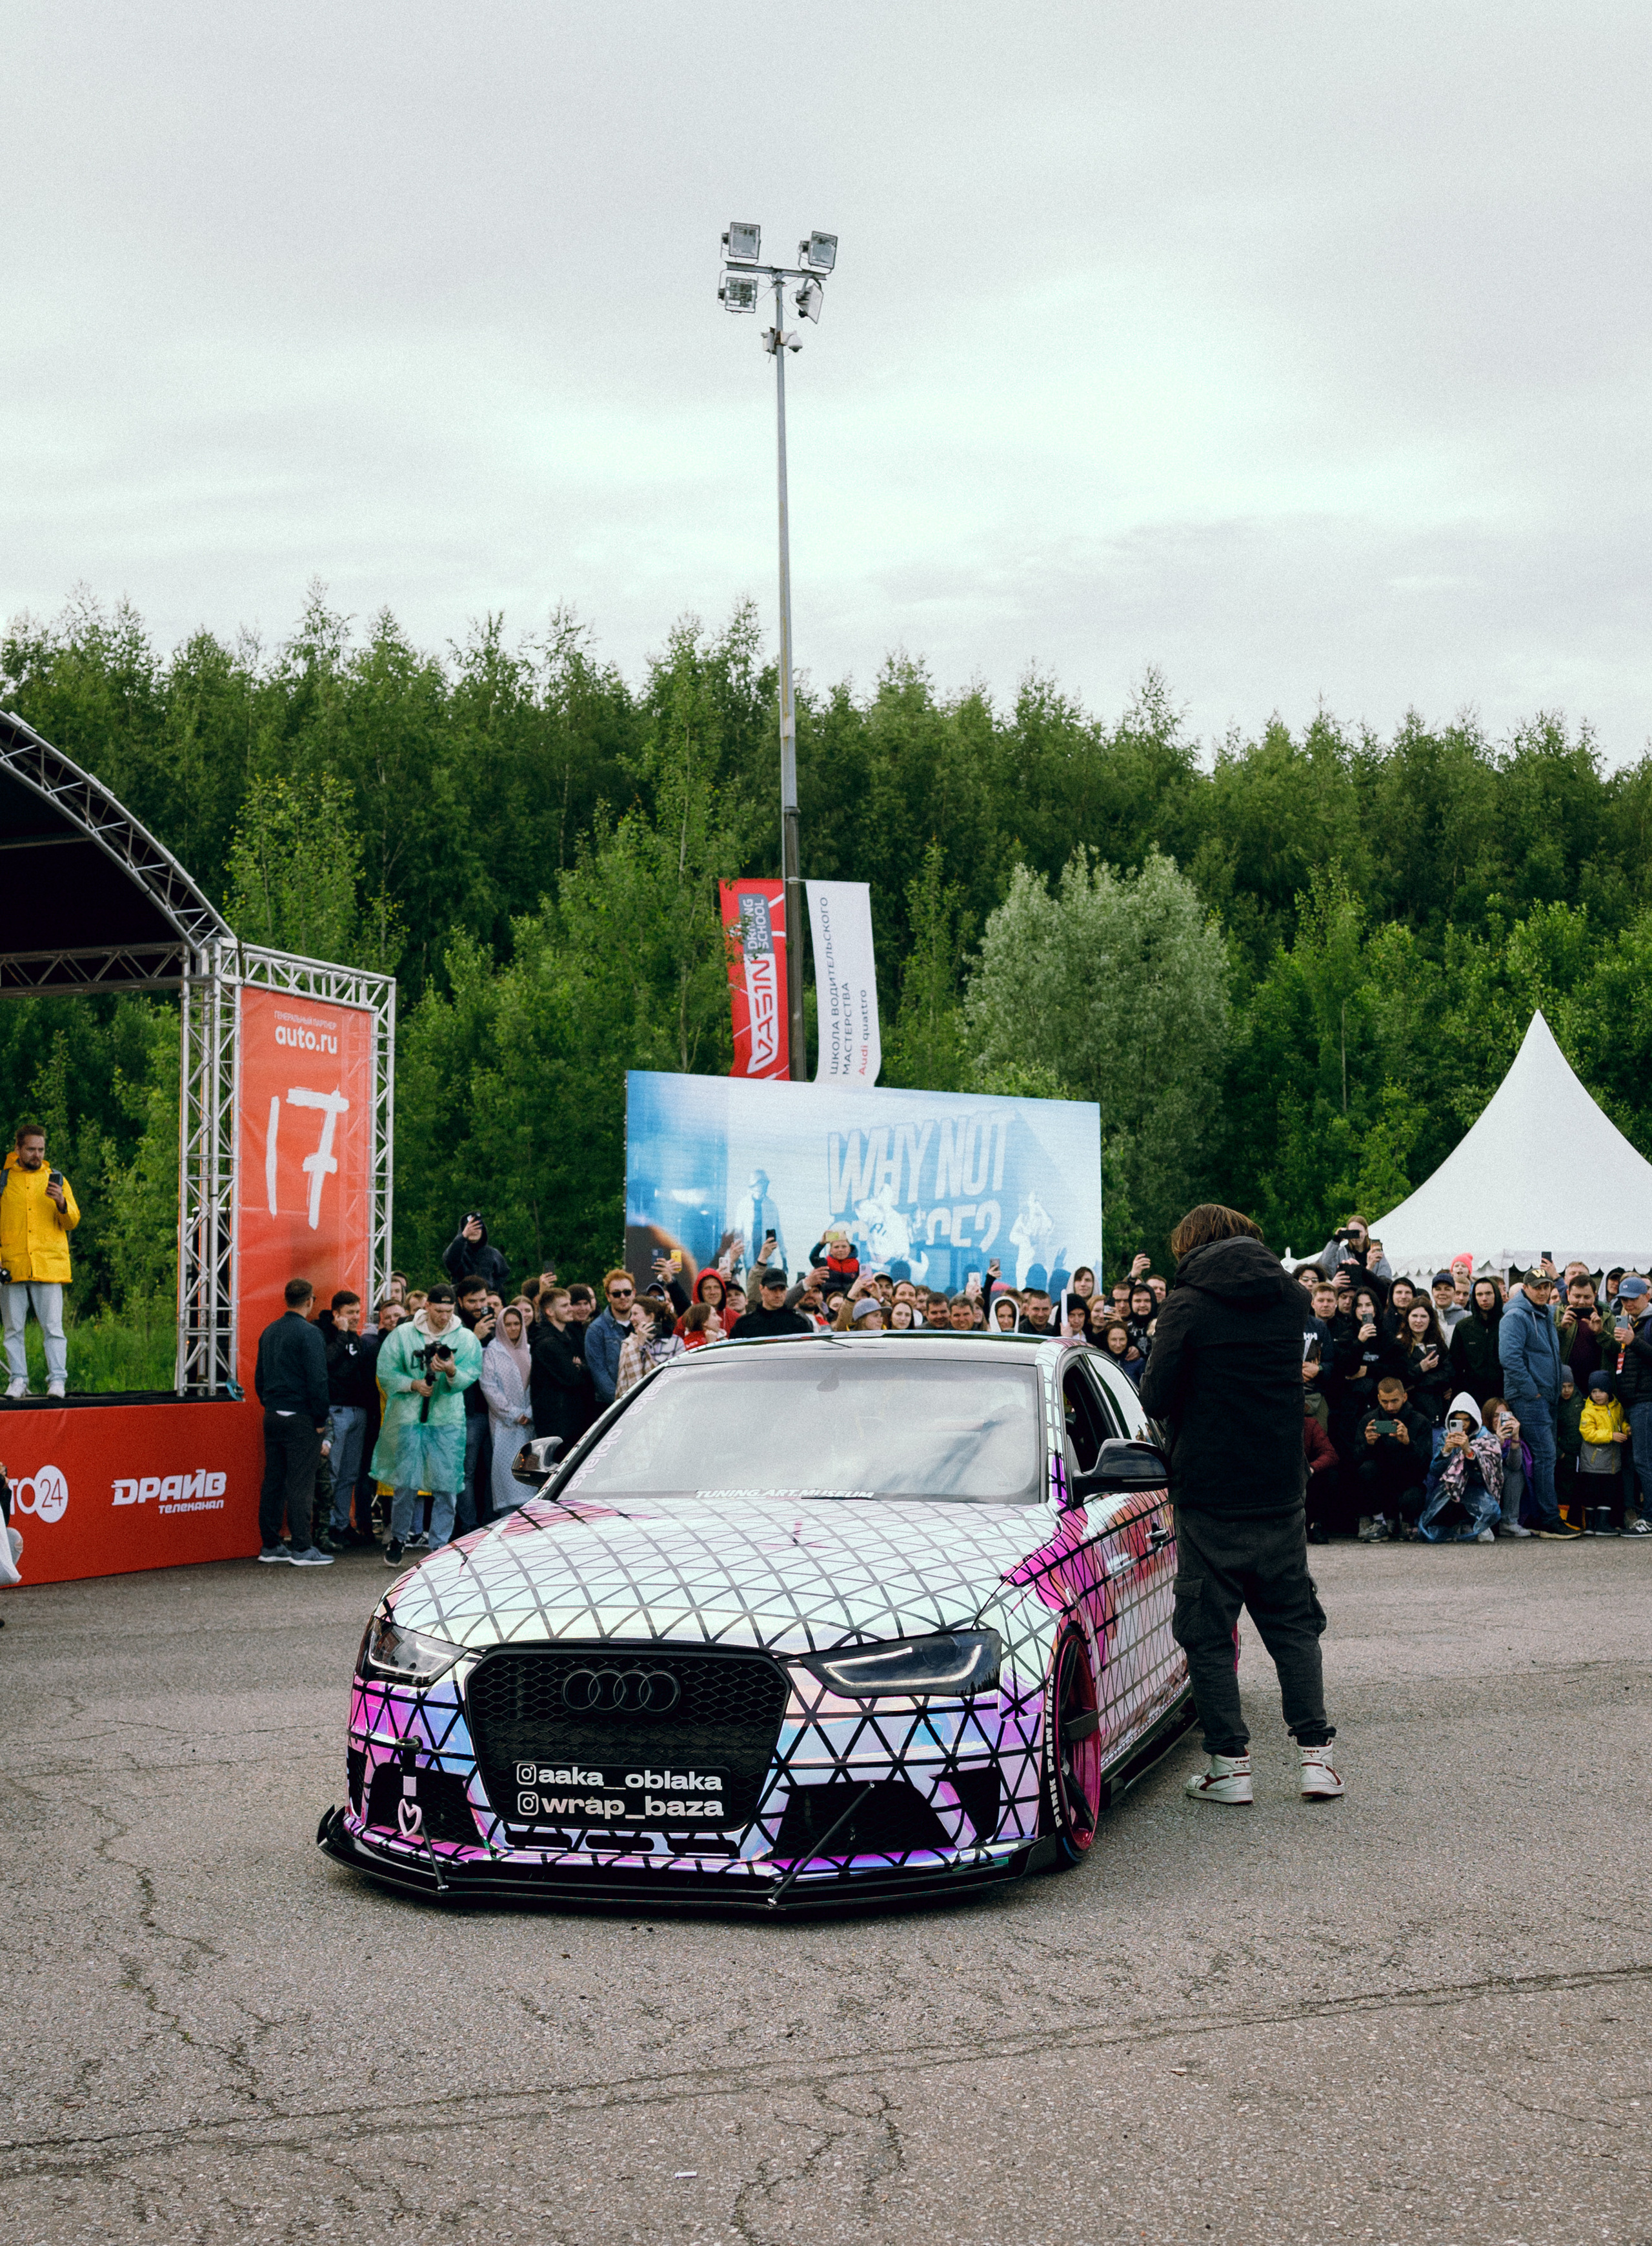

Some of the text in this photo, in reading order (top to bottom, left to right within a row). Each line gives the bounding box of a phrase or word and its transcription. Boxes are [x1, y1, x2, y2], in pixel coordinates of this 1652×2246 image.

[754, 898, 770, 949] SCHOOL
[820, 896, 840, 1075] ШКОЛА ВОДИТЕЛЬСКОГО
[841, 982, 854, 1075] МАСТЕРСТВА
[275, 1025, 337, 1055] auto.ru
[858, 989, 869, 1076] Audi quattro
[265, 1085, 350, 1231] 17
[828, 1110, 1016, 1216] WHY NOT
[541, 1796, 724, 1820] wrap_baza
[1049, 1778, 1062, 1828] PINK
